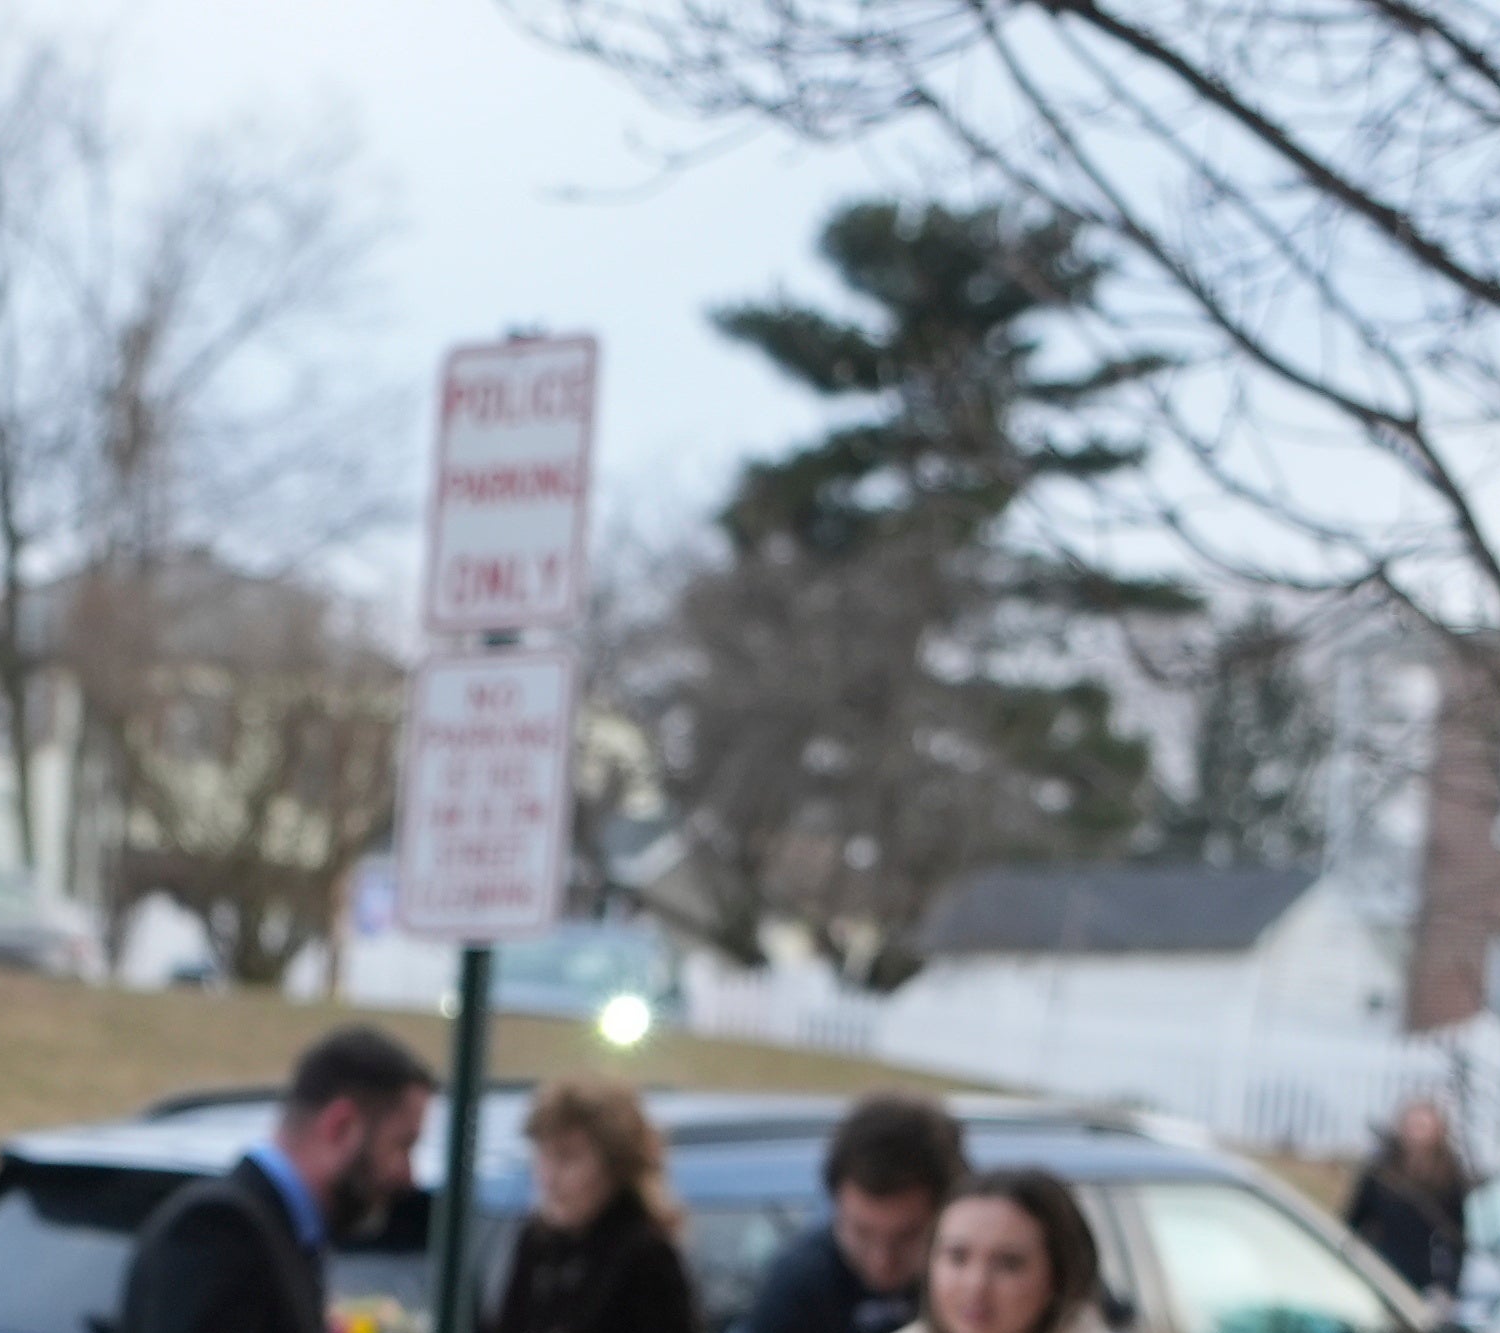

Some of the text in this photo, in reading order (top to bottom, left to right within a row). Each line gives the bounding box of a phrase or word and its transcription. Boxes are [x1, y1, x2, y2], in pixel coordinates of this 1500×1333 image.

[442, 367, 591, 423] POLICE
[441, 460, 583, 507] PARKING
[449, 553, 562, 607] ONLY
